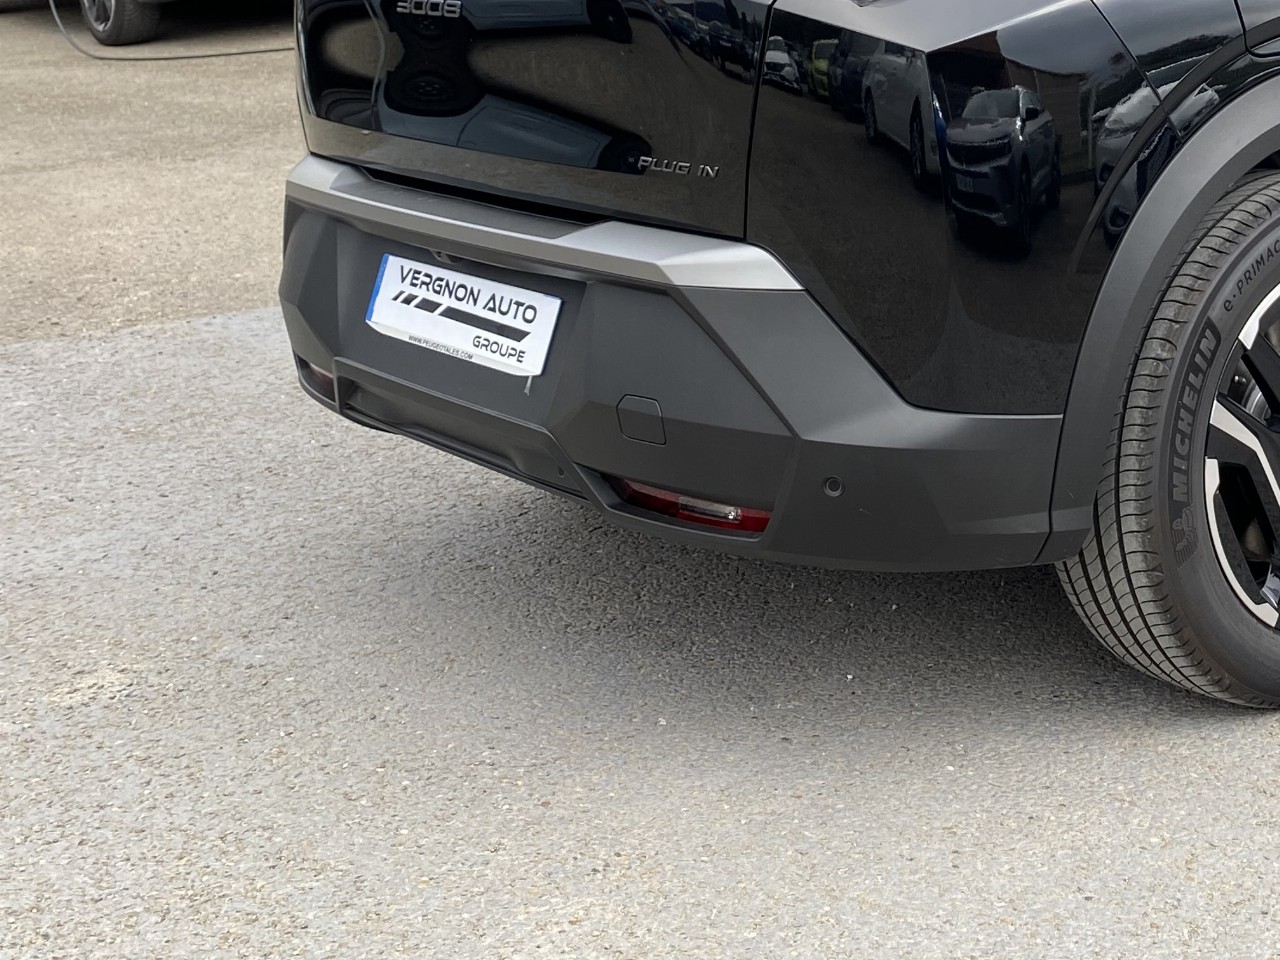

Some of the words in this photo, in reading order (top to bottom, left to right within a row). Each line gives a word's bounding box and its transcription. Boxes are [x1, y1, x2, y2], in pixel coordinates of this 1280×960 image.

[637, 155, 691, 176] PLUG
[697, 164, 719, 179] IN
[400, 265, 481, 307] VERGNON
[482, 293, 538, 324] AUTO
[472, 335, 526, 364] GROUPE
[1173, 326, 1219, 503] MICHELIN
